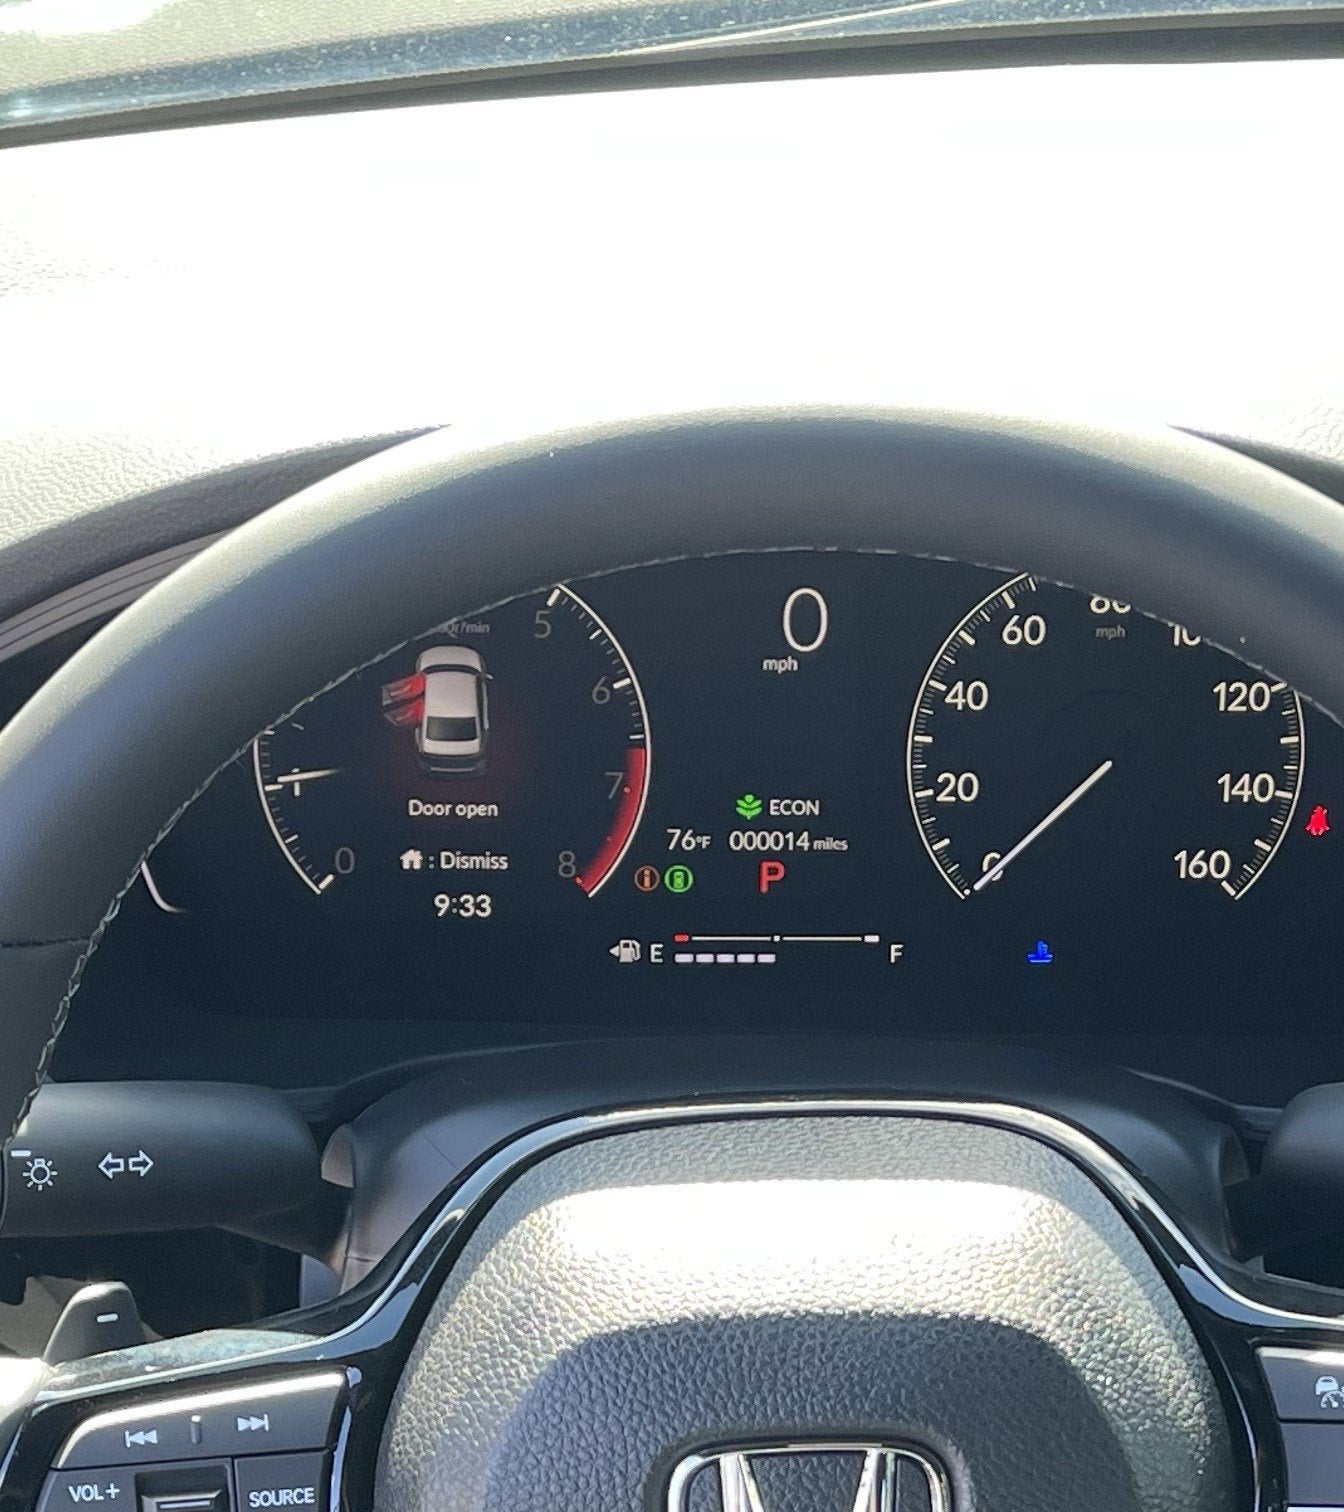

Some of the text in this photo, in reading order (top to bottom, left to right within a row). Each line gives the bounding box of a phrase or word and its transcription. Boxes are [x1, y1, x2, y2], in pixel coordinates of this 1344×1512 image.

[534, 609, 553, 639] 5
[782, 587, 829, 653] 0
[1001, 616, 1047, 645] 60
[1095, 624, 1127, 640] mph
[762, 656, 799, 674] mph
[591, 678, 612, 705] 6
[945, 681, 989, 711] 40
[1212, 681, 1271, 713] 120
[604, 771, 624, 799] 7
[935, 772, 980, 802] 20
[1217, 773, 1276, 803] 140
[408, 798, 499, 820] Door open
[768, 799, 821, 816] ECON
[728, 830, 849, 851] 000014 miles
[334, 847, 355, 875] 0
[439, 850, 509, 870] Dismiss
[557, 850, 577, 878] 8
[1174, 850, 1231, 880] 160
[758, 859, 786, 895] P
[433, 893, 492, 917] 9:33
[649, 942, 664, 964] E
[889, 943, 905, 965] F
[68, 1482, 121, 1503] VOL+
[248, 1486, 315, 1508] SOURCE
